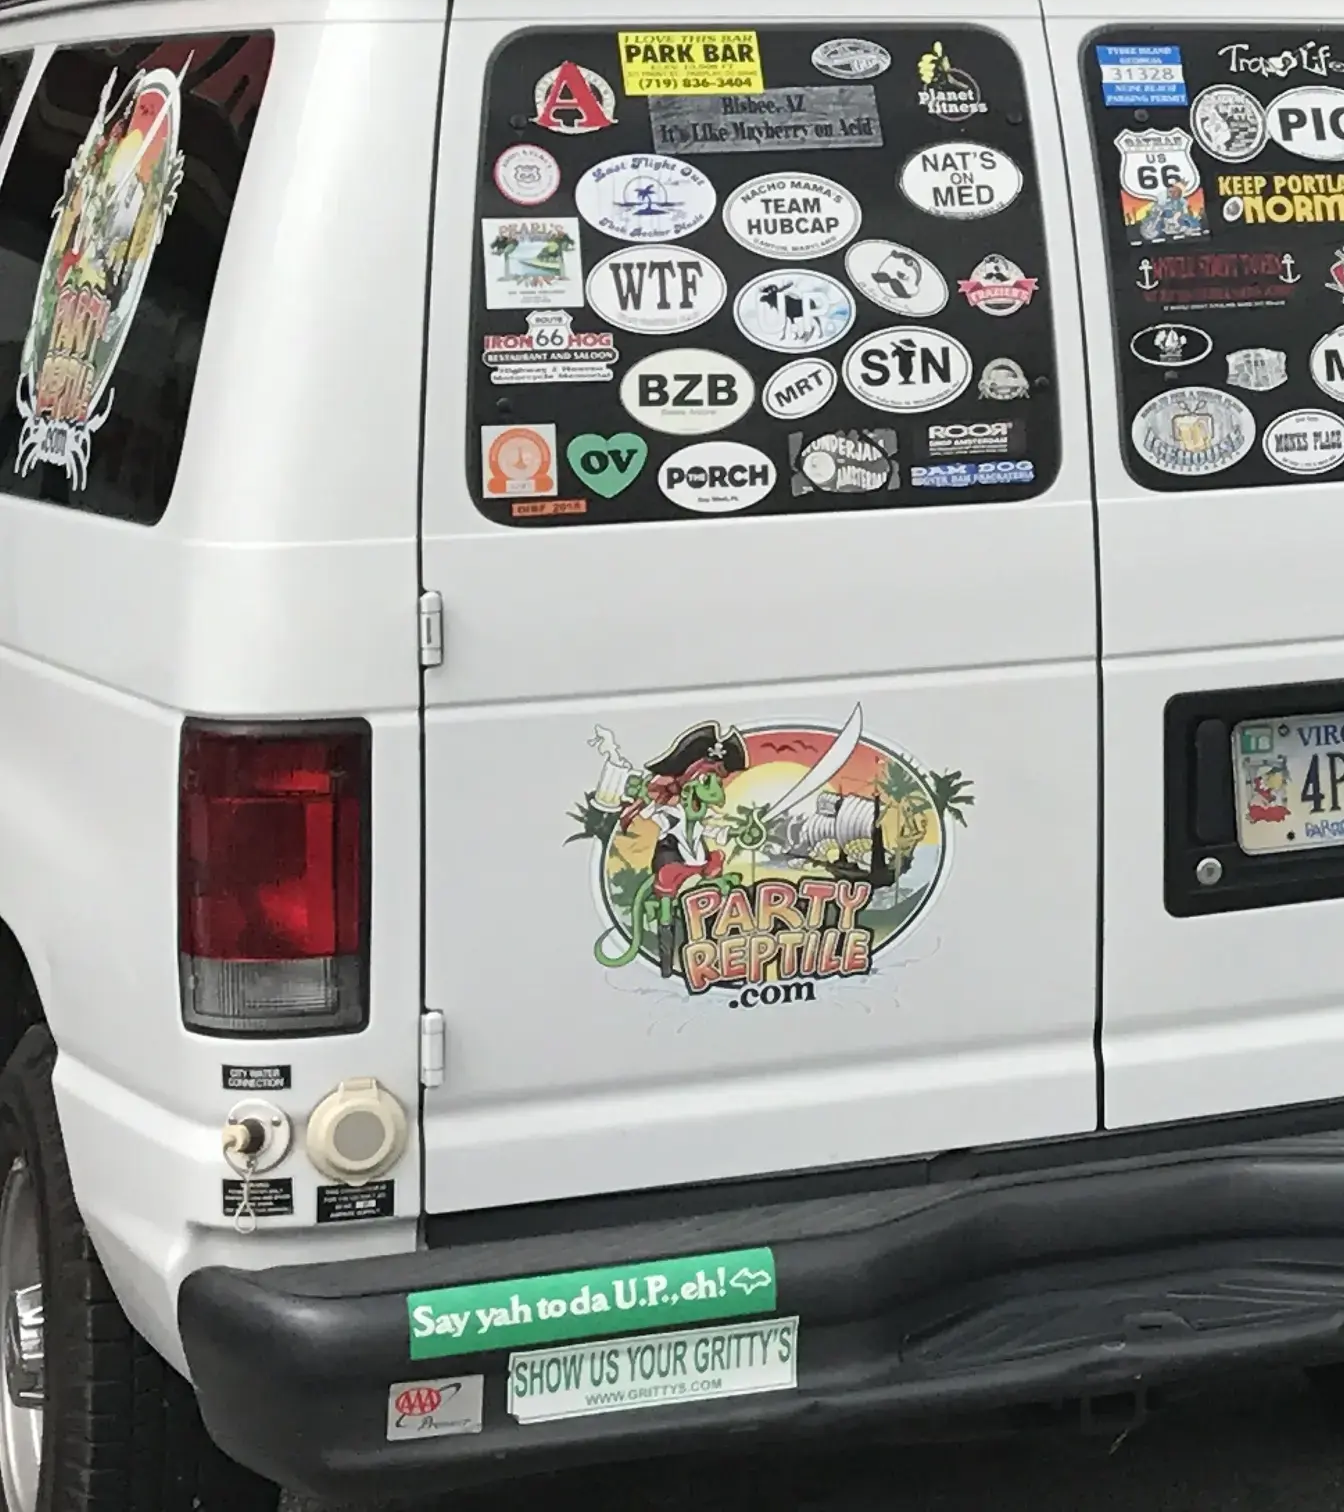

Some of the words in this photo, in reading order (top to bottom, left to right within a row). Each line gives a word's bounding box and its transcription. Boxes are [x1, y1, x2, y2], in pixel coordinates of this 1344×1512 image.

[633, 35, 676, 44] LOVE
[687, 35, 717, 44] THIS
[721, 34, 753, 43] BAR
[625, 44, 696, 64] PARK
[704, 43, 755, 64] BAR
[638, 77, 678, 89] (719)
[1112, 67, 1175, 81] 31328
[918, 88, 975, 105] planet
[927, 100, 989, 114] fitness
[732, 120, 809, 144] Mayberry
[815, 123, 834, 137] on
[840, 118, 874, 137] Acid
[921, 151, 997, 172] NAT'S
[1146, 154, 1167, 164] US
[592, 161, 627, 183] Last
[631, 157, 677, 173] Flight
[680, 166, 706, 188] Out
[950, 172, 974, 185] ON
[1137, 165, 1182, 190] 66
[741, 181, 786, 204] NACHO
[790, 180, 844, 204] MAMA'S
[932, 185, 994, 207] MED
[1217, 175, 1267, 196] KEEP
[760, 197, 822, 215] TEAM
[746, 217, 840, 236] HUBCAP
[609, 260, 704, 311] WTF
[535, 316, 563, 324] ROUTE
[484, 336, 533, 349] IRON
[535, 329, 565, 348] 66
[567, 334, 612, 348] HOG
[551, 351, 573, 361] AND
[574, 350, 614, 361] SALOON
[638, 374, 739, 407] BZB
[774, 369, 825, 408] MRT
[580, 449, 638, 475] OV
[684, 880, 872, 941] PARTY
[684, 929, 872, 991] REPTILE
[728, 982, 816, 1008] .com
[228, 1077, 285, 1088] CONNECTION
[230, 1069, 248, 1077] CITY
[250, 1069, 280, 1077] WATER
[413, 1305, 470, 1338] Say
[476, 1294, 532, 1333] yah
[537, 1294, 563, 1320] to
[570, 1287, 610, 1315] da
[680, 1266, 727, 1300] eh!
[515, 1355, 584, 1398] SHOW
[589, 1353, 620, 1387] US
[627, 1342, 687, 1383] YOUR
[693, 1326, 792, 1374] GRITTY'S
[398, 1388, 439, 1414] AAA
[584, 1377, 723, 1407] WWW.GRITTYS.COM
